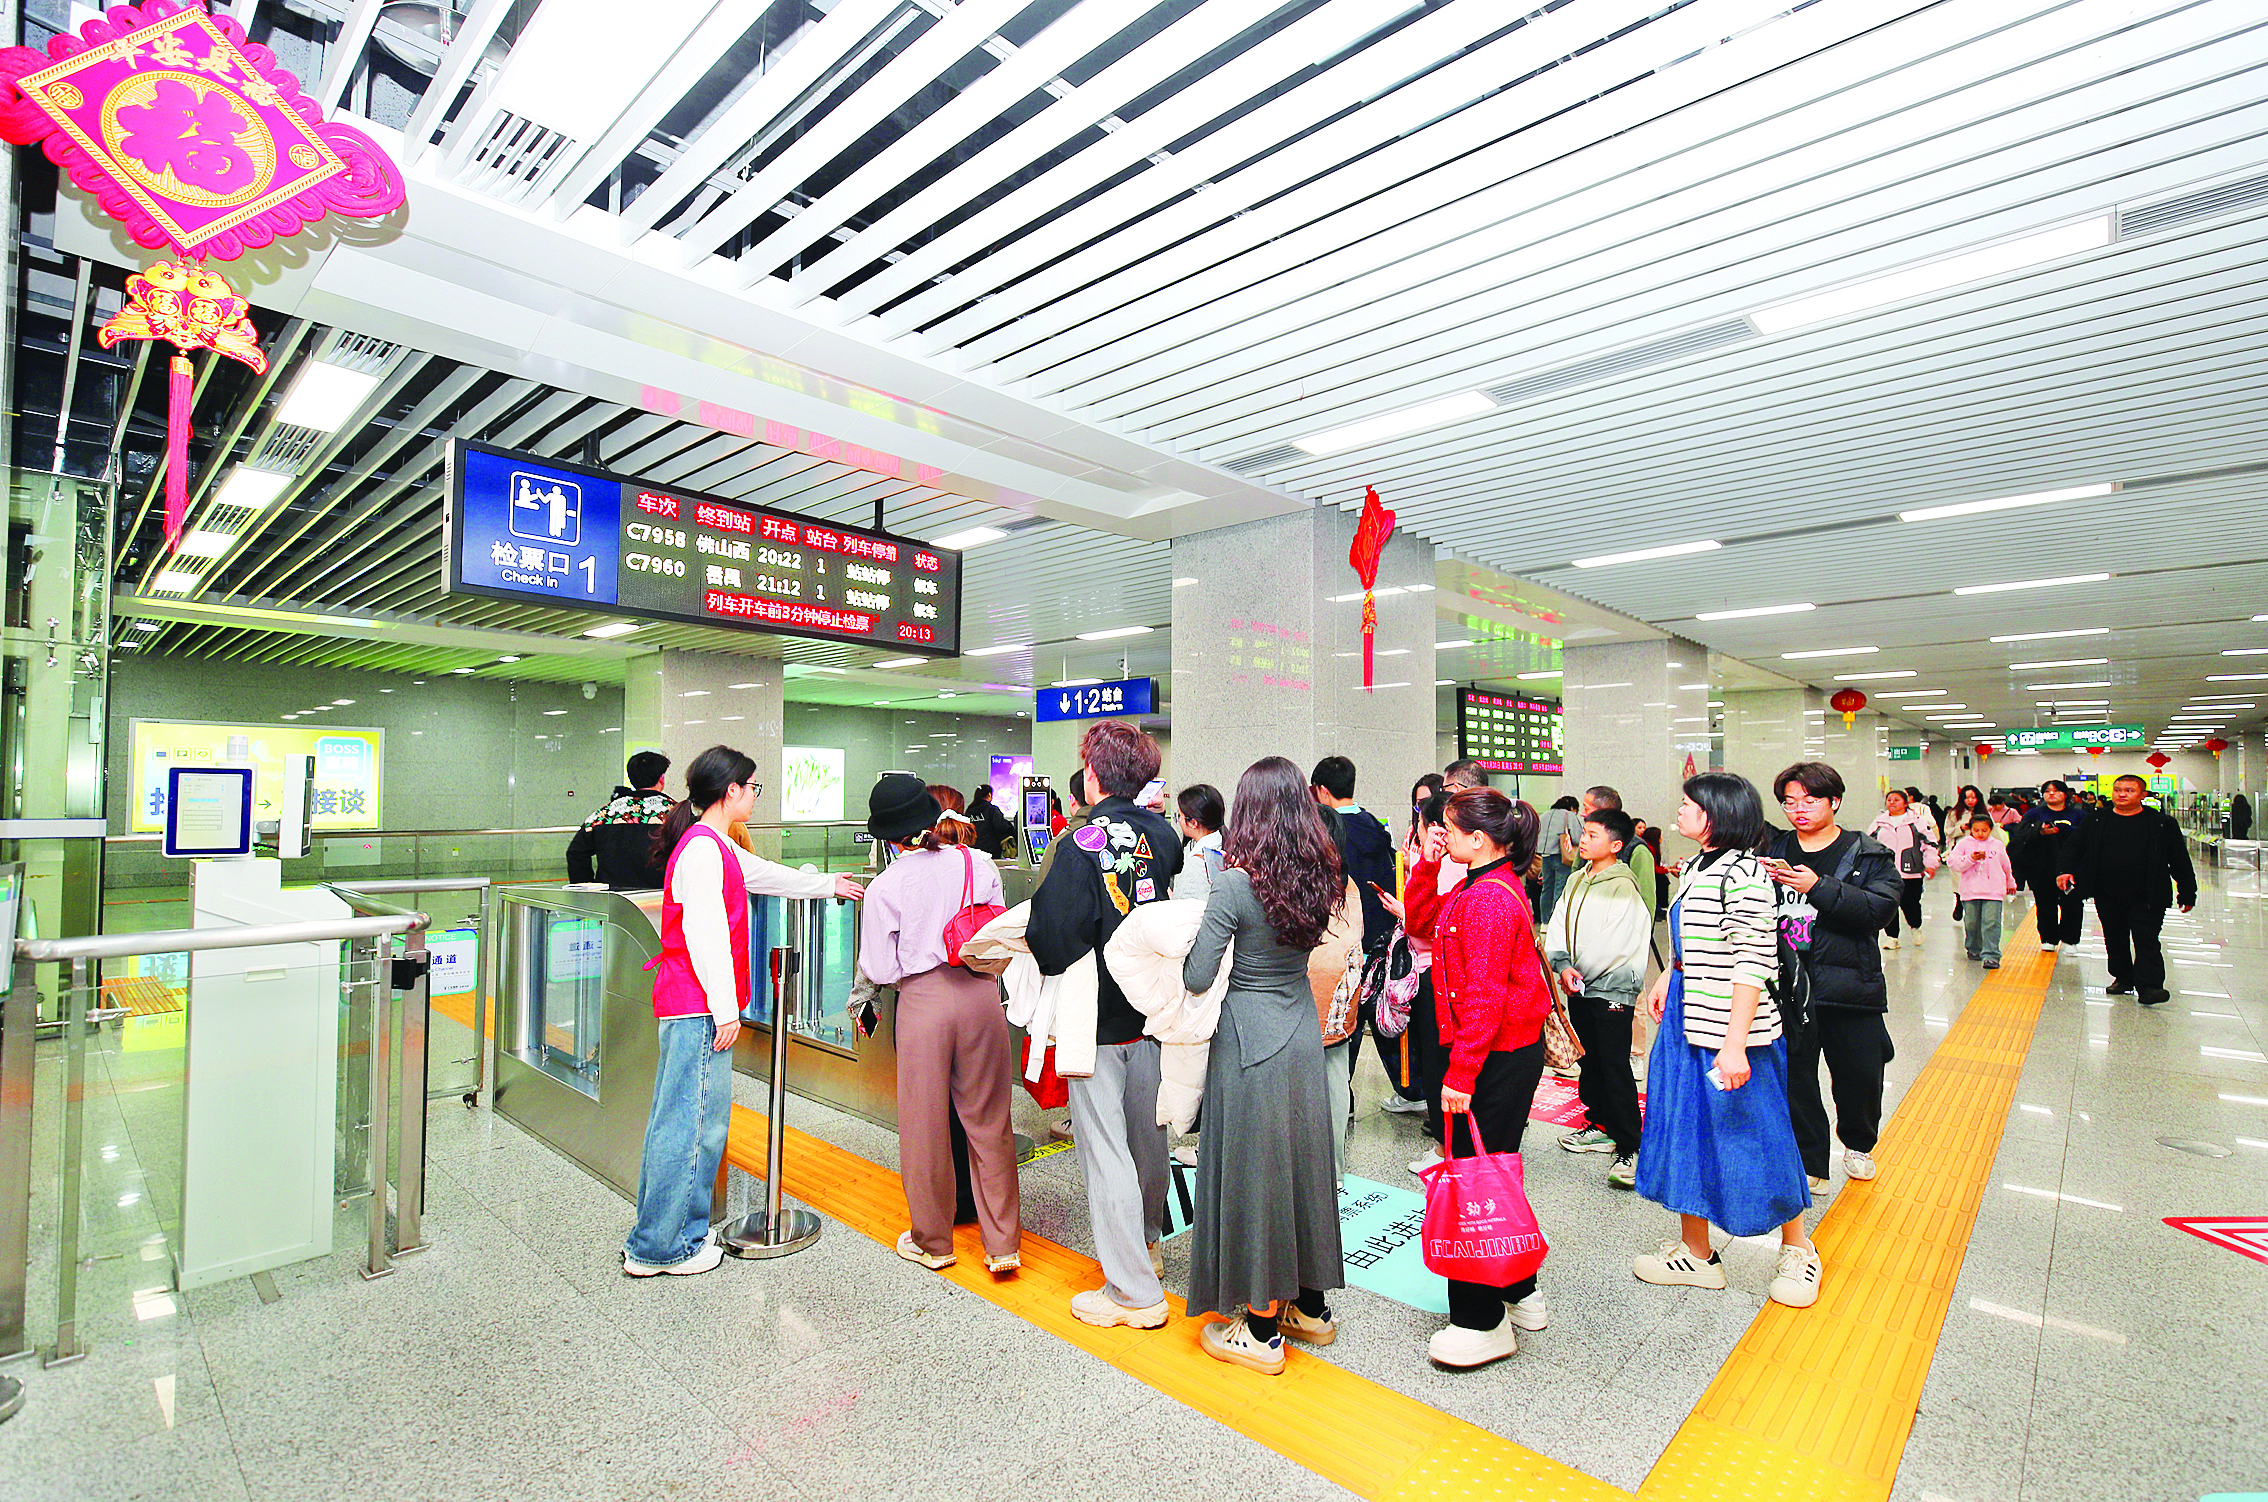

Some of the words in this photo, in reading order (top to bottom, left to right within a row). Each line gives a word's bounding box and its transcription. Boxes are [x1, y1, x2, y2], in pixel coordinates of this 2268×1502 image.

[637, 493, 679, 518] 车次
[696, 504, 752, 533] 终到站
[763, 518, 797, 542] 开点
[805, 528, 838, 550] 站台
[490, 540, 571, 576] 检票口
[578, 555, 597, 594] 1
[626, 522, 687, 549] C7958
[695, 533, 752, 562] 佛山西
[757, 546, 802, 570] 20:22
[816, 557, 827, 574] 1
[501, 569, 543, 586] Check
[546, 576, 559, 589] in
[625, 552, 686, 578] C7960
[756, 574, 801, 597] 21:12
[816, 583, 826, 601] 1
[707, 592, 870, 631] 列车开车前3分钟停止检票
[899, 625, 931, 640] 20:13
[324, 744, 360, 755] BOSS
[1458, 1198, 1496, 1218] 劲步
